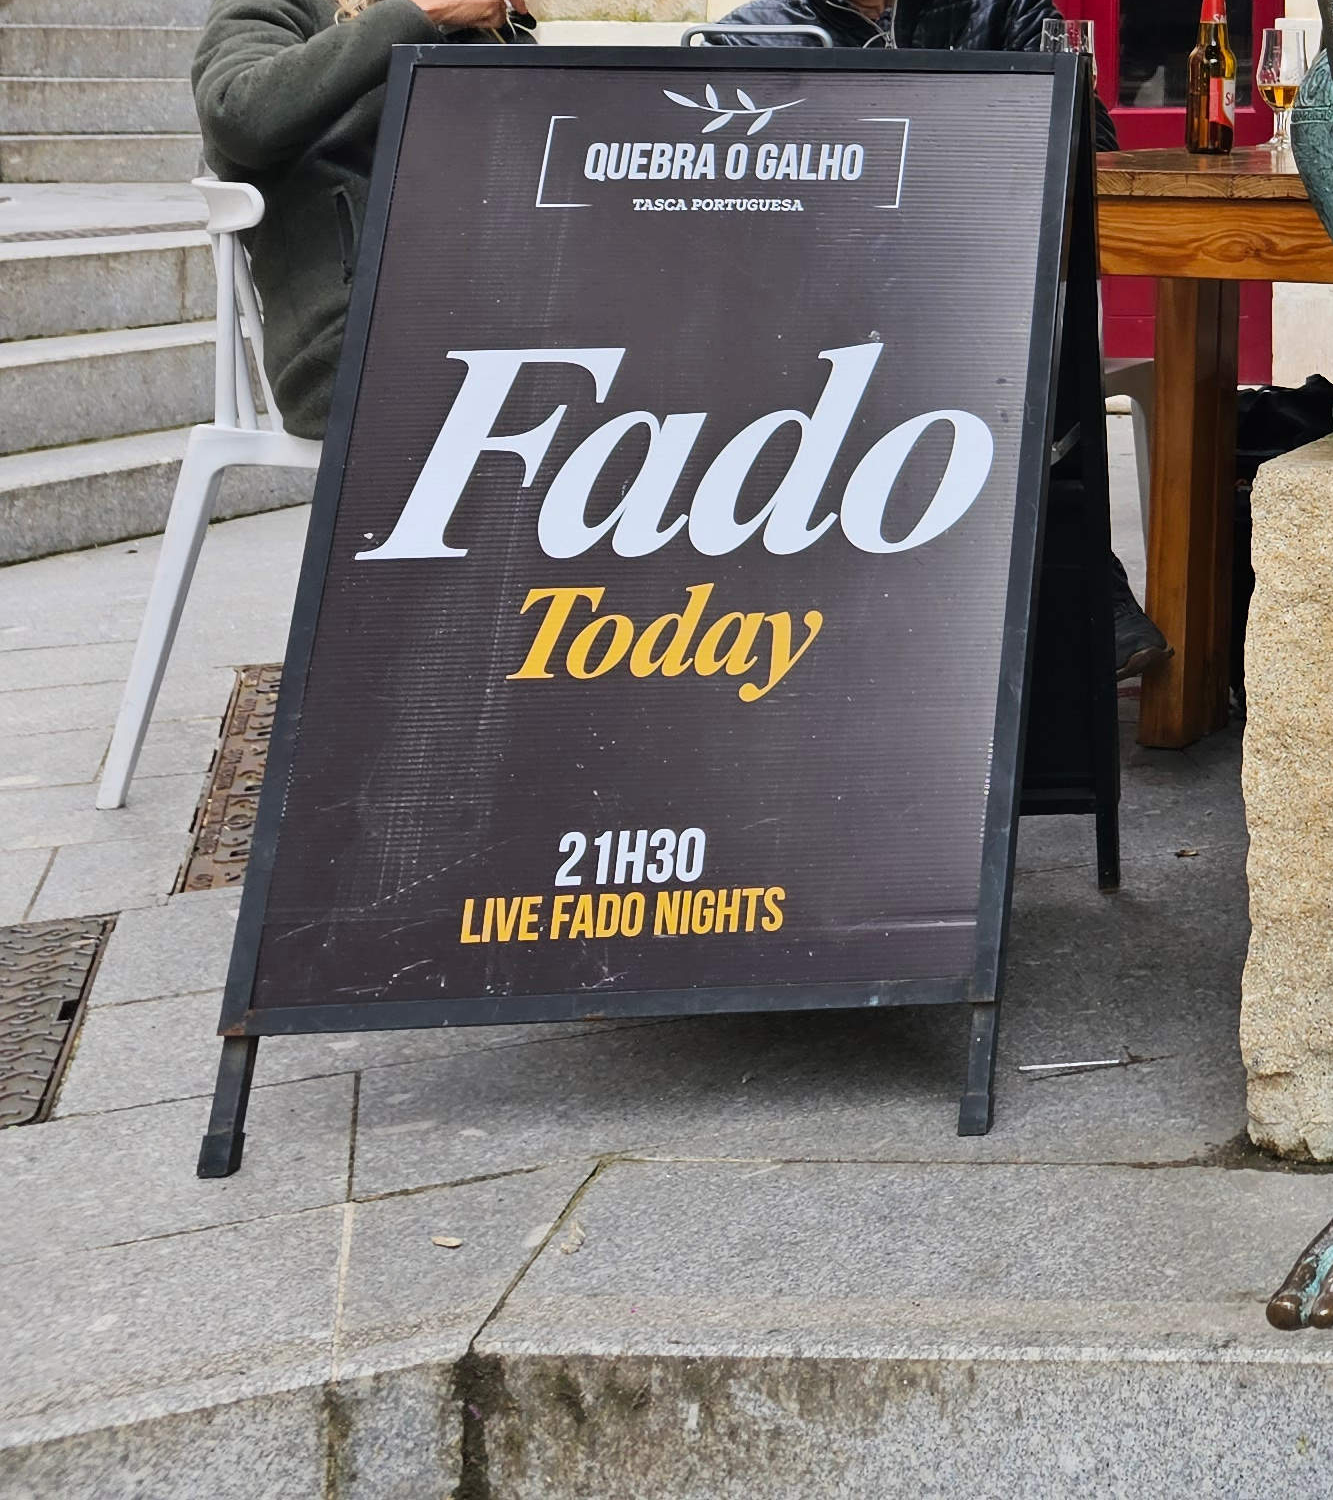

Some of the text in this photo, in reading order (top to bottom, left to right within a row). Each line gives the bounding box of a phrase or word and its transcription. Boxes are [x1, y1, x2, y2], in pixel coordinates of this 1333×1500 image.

[584, 142, 865, 182] QUEBRA O GALHO
[632, 198, 805, 212] TASCA PORTUGUESA
[354, 342, 995, 561] Fado
[505, 582, 824, 702] Today
[554, 826, 707, 887] 21H30
[460, 886, 786, 944] LIVE FADO NIGHTS
